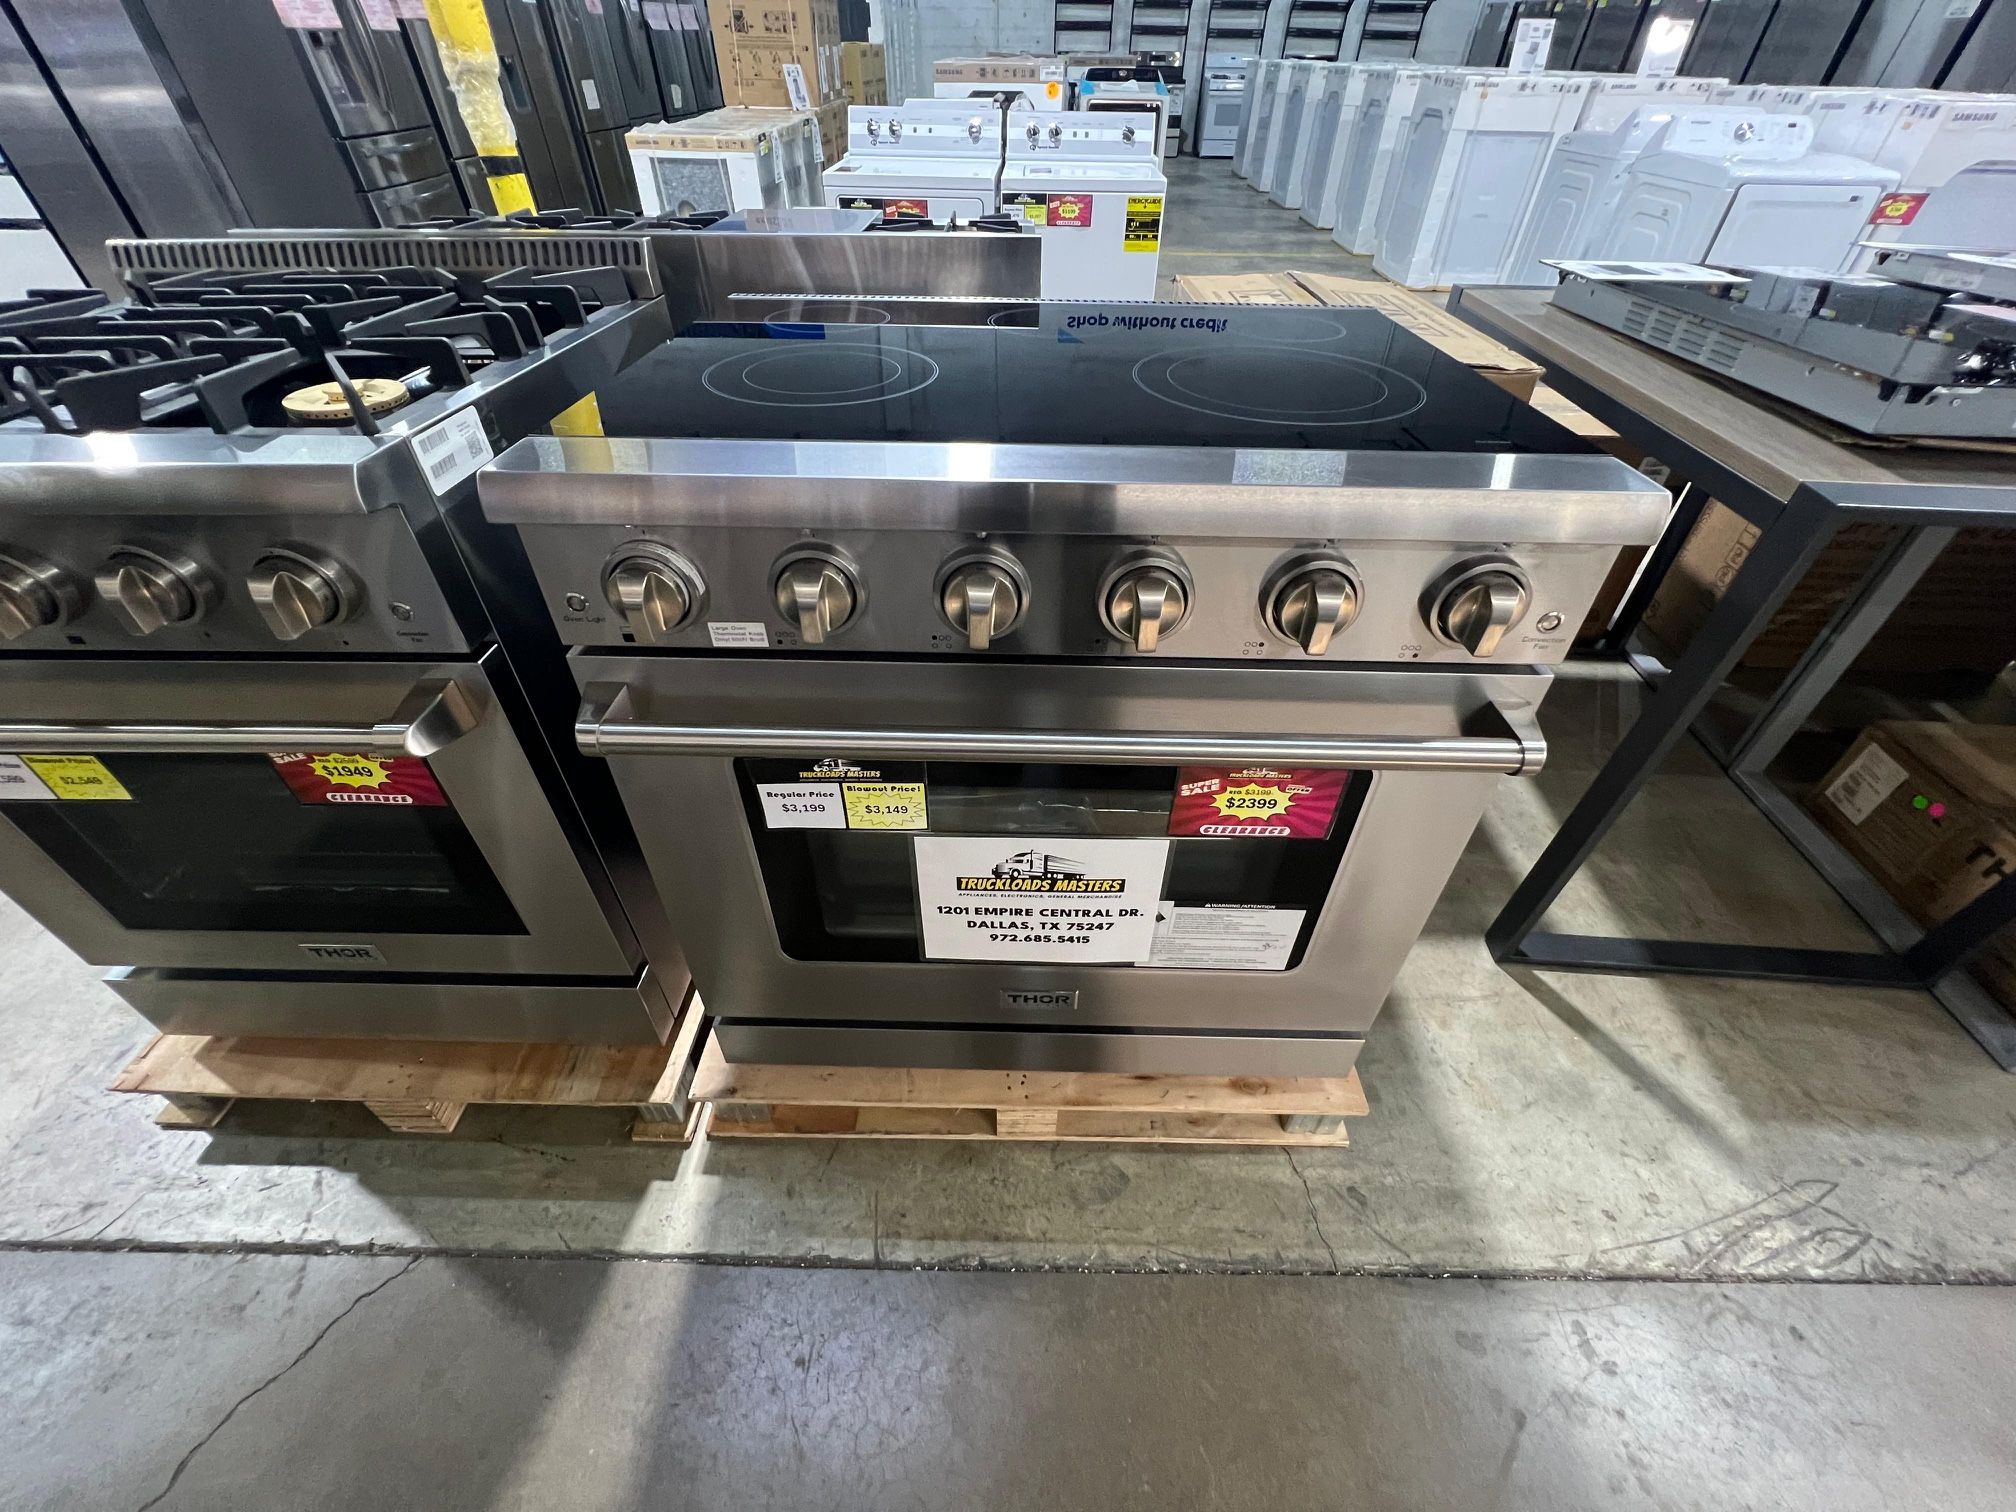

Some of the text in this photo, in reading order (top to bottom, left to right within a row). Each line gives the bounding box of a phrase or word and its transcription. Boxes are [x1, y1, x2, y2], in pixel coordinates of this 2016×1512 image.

[1951, 112, 1998, 122] SAMSUNG
[321, 765, 374, 777] $1949
[846, 770, 881, 778] MASTERS
[1181, 778, 1220, 790] SUPER
[1181, 783, 1220, 796] SALE
[330, 794, 409, 802] CLEARANCE
[766, 791, 806, 799] Regular
[781, 803, 826, 813] $3,199
[1225, 797, 1278, 809] $2399
[865, 804, 908, 815] $3,149
[1203, 826, 1287, 835] CLEARANCE
[960, 878, 1122, 892] TRUCKLOADS MASTERS
[937, 906, 1145, 918] 1201 EMPIRE CENTRAL DR.
[966, 920, 1115, 931] DALLAS, TX 75247
[989, 933, 1090, 944] 972.685.5415
[307, 947, 373, 958] THOR
[1007, 994, 1070, 1004] THOR
